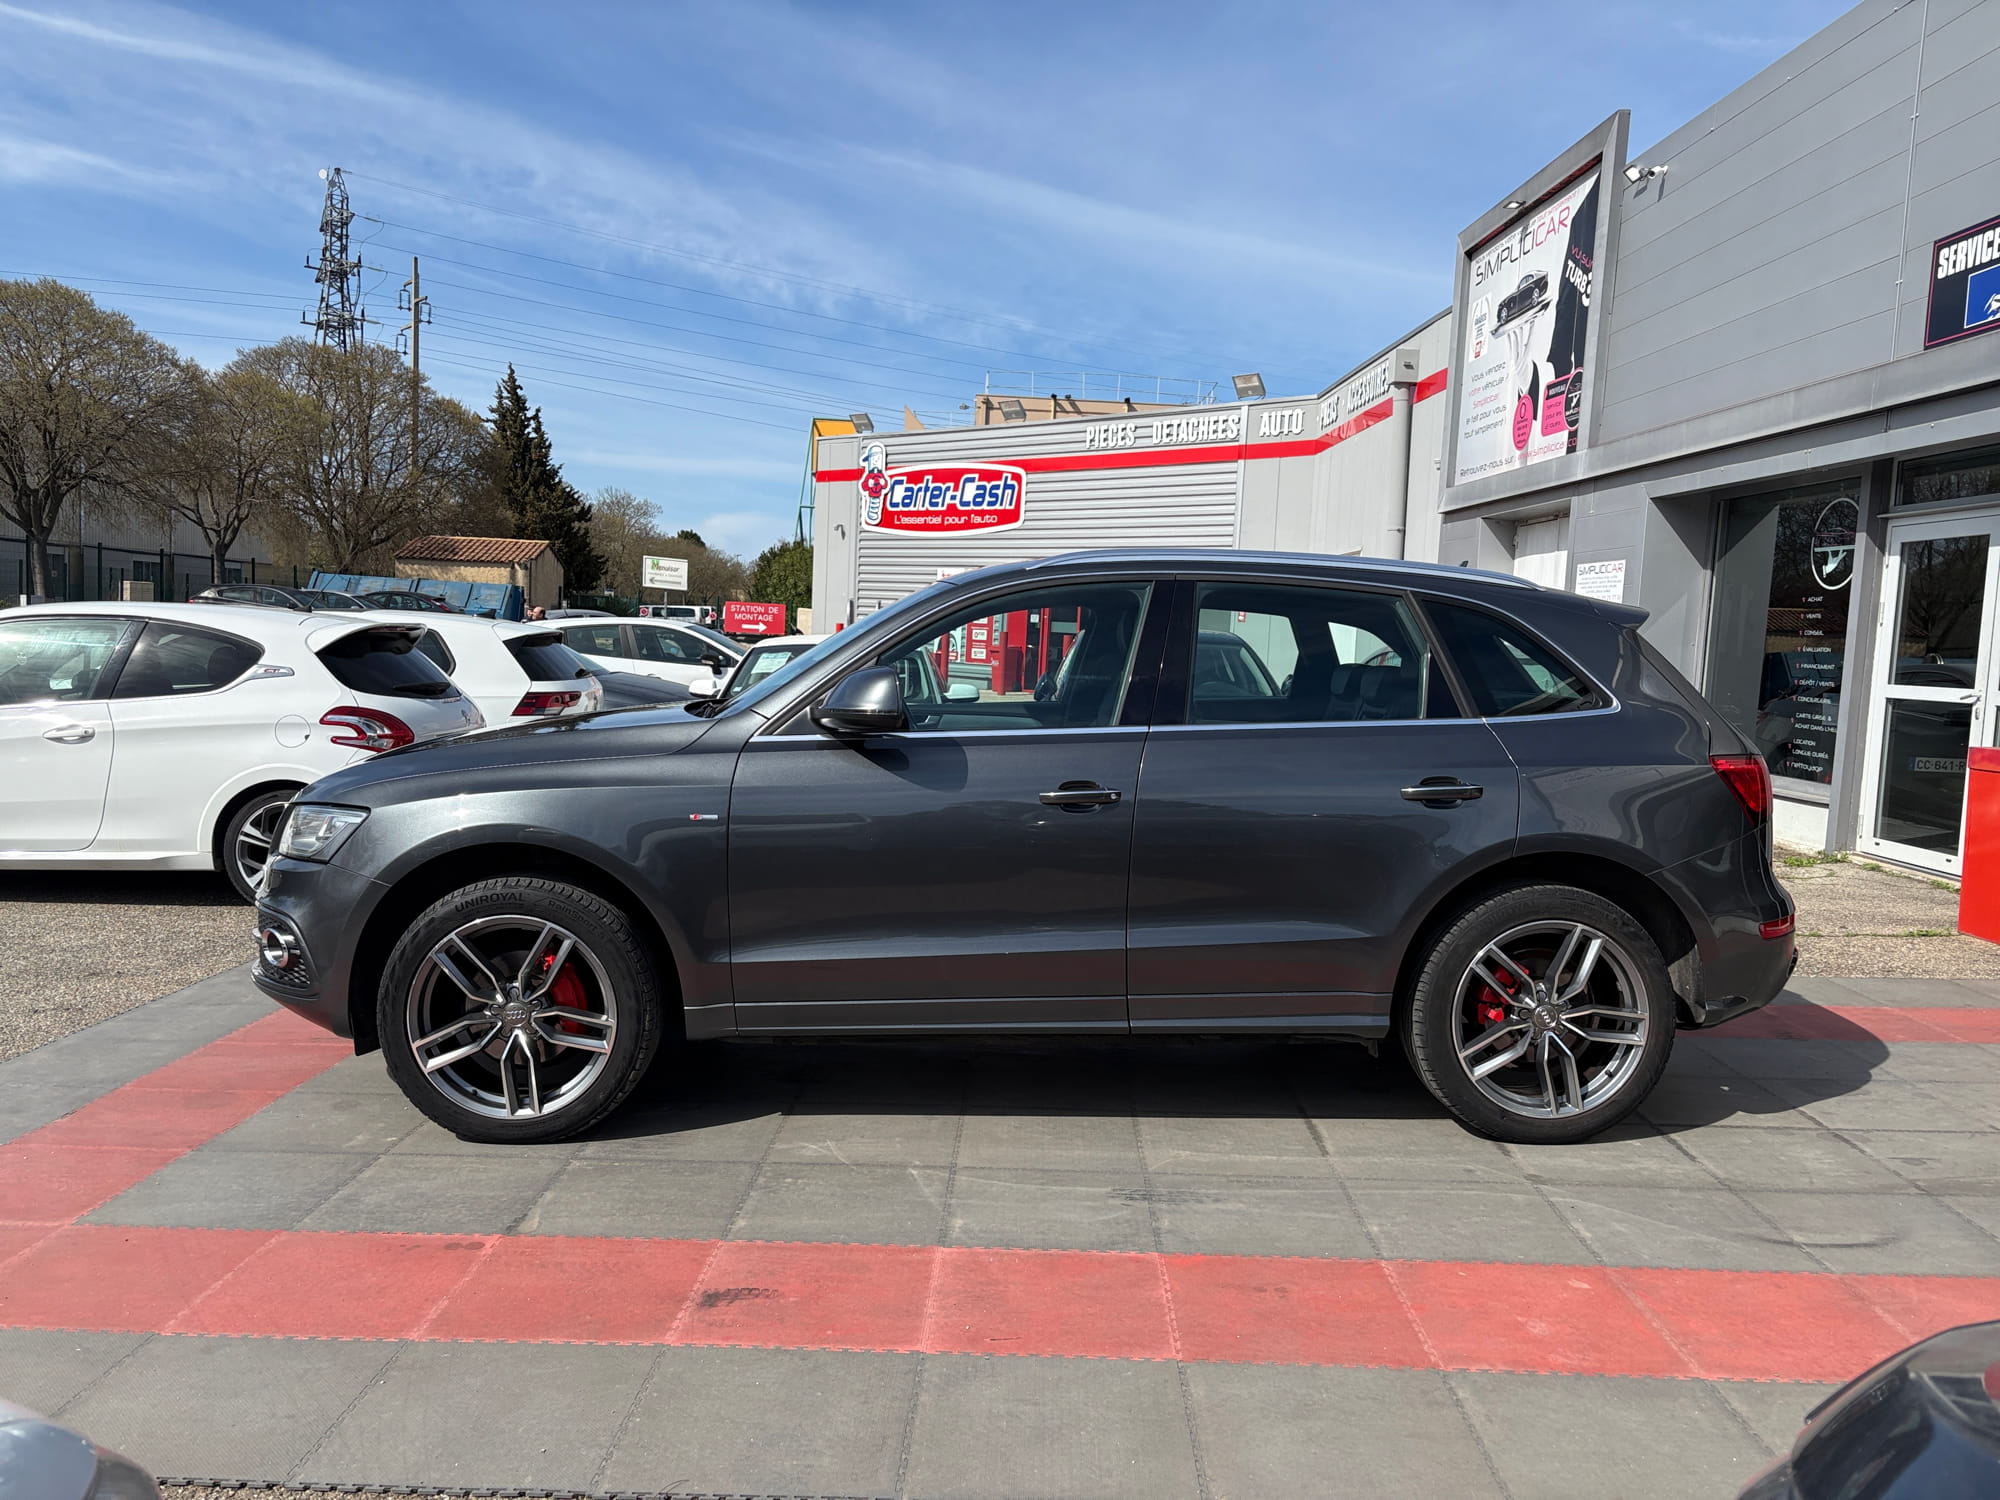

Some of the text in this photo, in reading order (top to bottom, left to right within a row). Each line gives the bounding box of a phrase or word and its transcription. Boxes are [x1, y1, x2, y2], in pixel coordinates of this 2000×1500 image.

[1475, 206, 1570, 287] SIMPLICICAR
[1086, 422, 1136, 449] PIECES
[1152, 414, 1240, 444] DETACHEES
[1259, 408, 1305, 437] AUTO
[889, 475, 1016, 509] Carter-Cash
[894, 513, 998, 526] L'essentiel pour l'auto
[730, 604, 779, 614] STATION DE
[734, 613, 774, 622] MONTAGE
[1793, 738, 1816, 746] LOCATION
[454, 892, 525, 913] UNIROYAL
